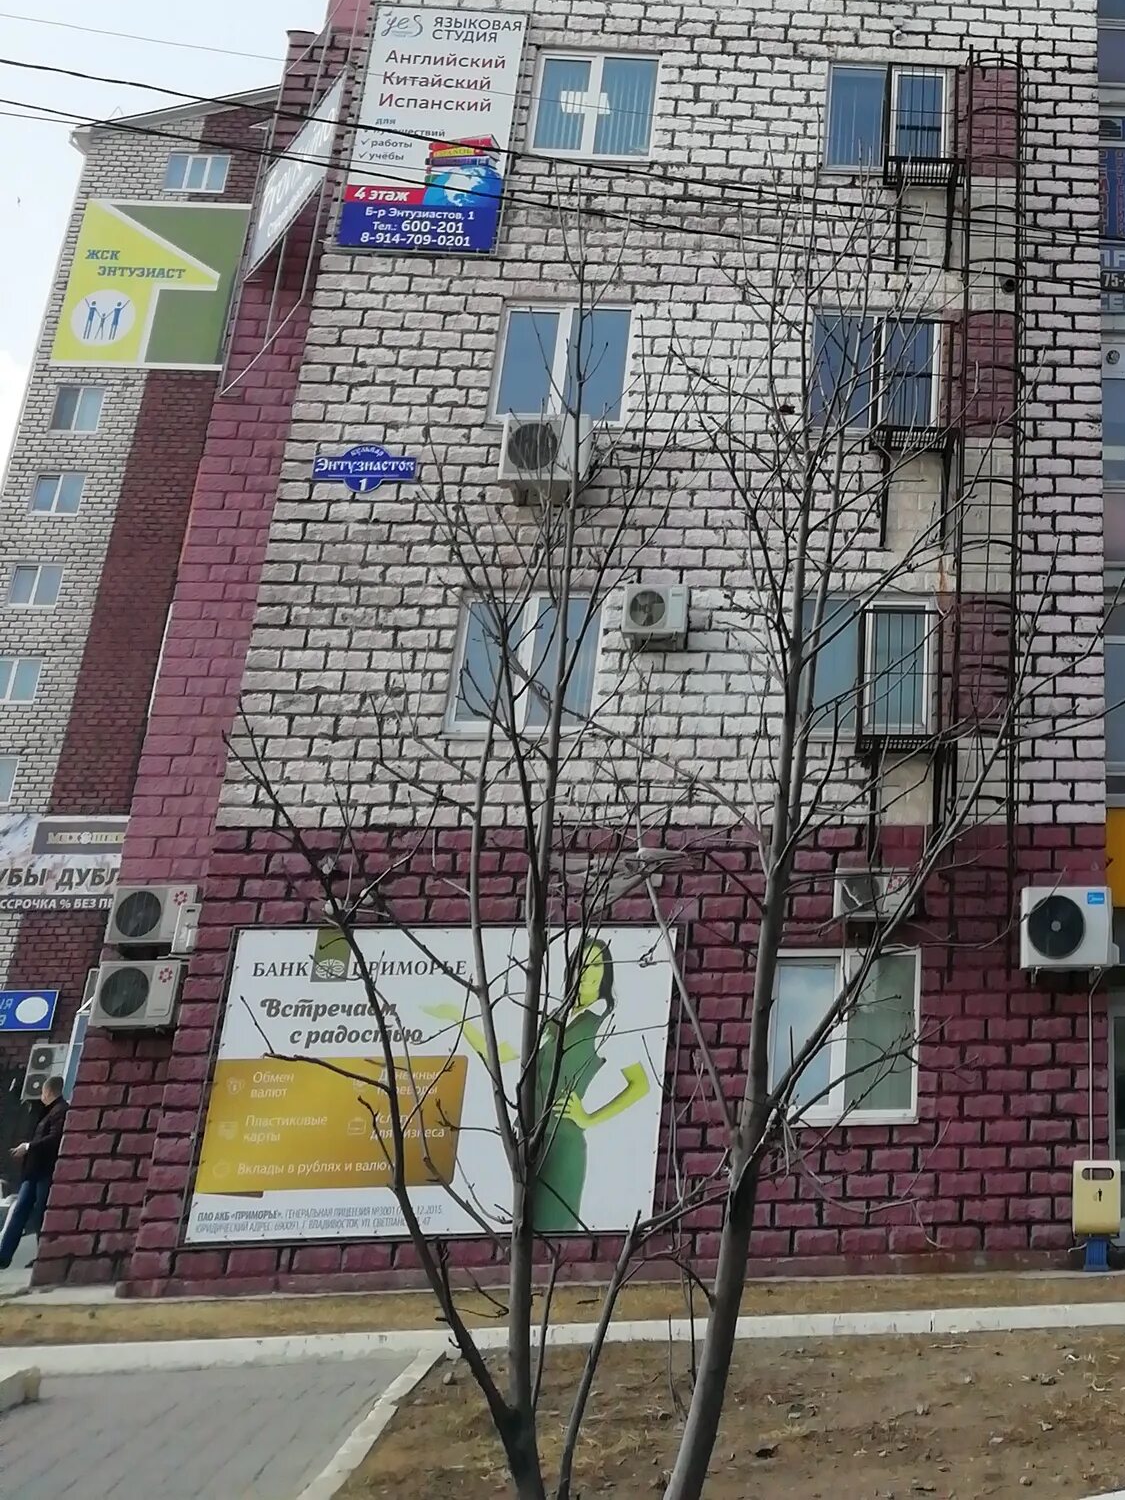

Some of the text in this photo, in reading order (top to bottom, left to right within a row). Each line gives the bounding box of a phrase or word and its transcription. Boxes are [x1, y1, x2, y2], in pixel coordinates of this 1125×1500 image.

[433, 16, 522, 32] ЯЗЫКОВАЯ
[432, 29, 498, 43] СТУДИЯ
[385, 50, 506, 69] Английский
[382, 71, 491, 90] Китайский
[378, 93, 492, 112] Испанский
[375, 118, 396, 126] для
[370, 139, 413, 149] работы
[354, 187, 410, 201] 4 этаж
[365, 207, 475, 220] Б-р Энтузиастов, 1
[372, 220, 464, 234] Тел.: 600-201
[360, 232, 470, 247] 8-914-709-0201
[85, 249, 120, 261] ЖСК
[97, 266, 187, 279] ЭНТУЗИАСТ
[359, 478, 368, 491] 1
[74, 899, 97, 909] БЕЗ
[252, 962, 311, 977] БАНК
[289, 1028, 303, 1044] с
[253, 1071, 294, 1084] Обмен
[250, 1087, 287, 1099] валют
[245, 1114, 328, 1127] Пластиковые
[243, 1131, 280, 1144] карты
[237, 1162, 284, 1175] Вклады
[288, 1164, 294, 1174] в
[298, 1161, 341, 1178] рублях
[344, 1163, 352, 1172] и
